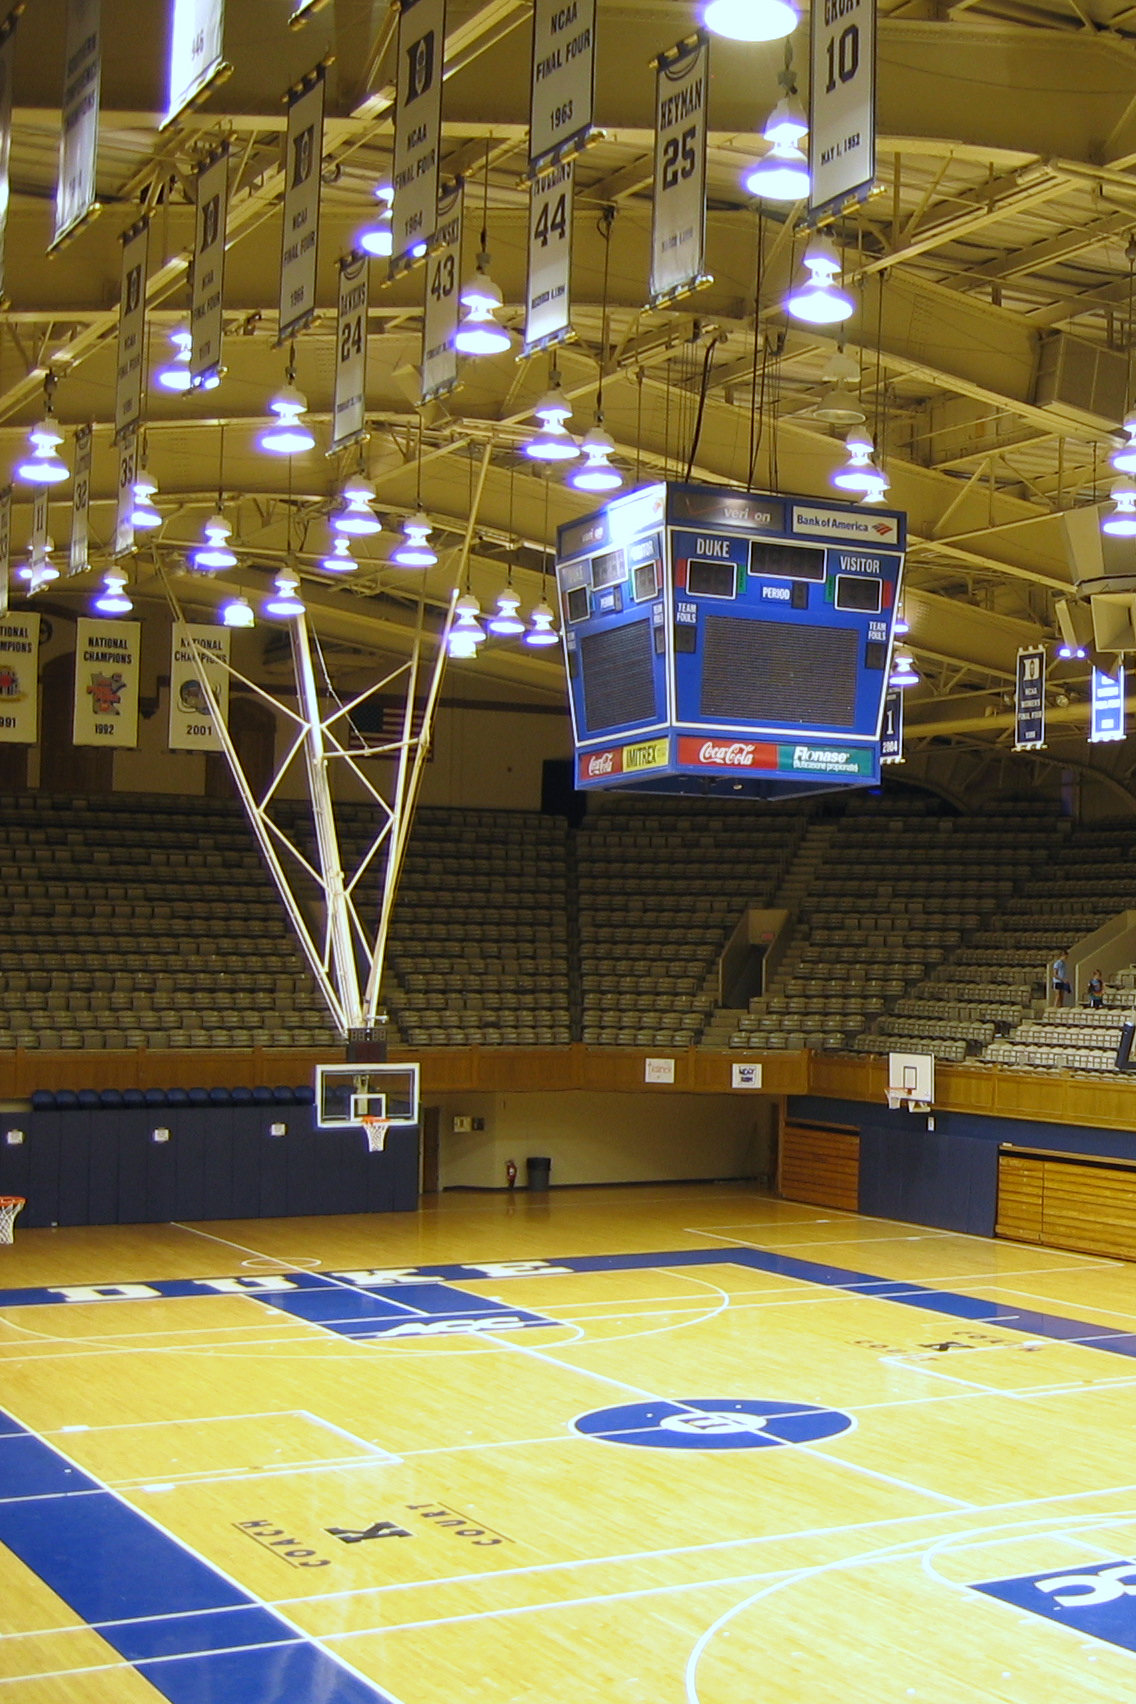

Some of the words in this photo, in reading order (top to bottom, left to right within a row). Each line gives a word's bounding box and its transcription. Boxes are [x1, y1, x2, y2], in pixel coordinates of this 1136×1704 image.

[551, 2, 577, 35] NCAA
[536, 49, 562, 83] FINAL
[566, 29, 590, 63] FOUR
[826, 23, 859, 94] 10
[551, 100, 573, 131] 1963
[660, 77, 702, 131] HEYMAN
[407, 124, 427, 151] NCAA
[395, 167, 414, 190] FINAL
[417, 149, 435, 182] FOUR
[663, 124, 696, 191] 25
[821, 147, 835, 165] MAY
[534, 193, 566, 248] 44
[431, 254, 454, 301] 43
[342, 315, 362, 362] 24
[121, 453, 133, 488] 35
[75, 479, 88, 511] 32
[797, 514, 820, 527] Bank
[820, 517, 832, 529] of
[832, 519, 868, 533] America
[697, 538, 730, 557] DUKE
[840, 556, 880, 573] VISITOR
[762, 587, 790, 600] PERIOD
[676, 613, 696, 624] FOULS
[678, 602, 697, 613] TEAM
[868, 631, 886, 641] FOULS
[869, 621, 886, 632] TEAM
[88, 637, 128, 649] NATIONAL
[83, 652, 132, 665] CHAMPIONS
[95, 724, 114, 735] 1992
[186, 725, 212, 736] 2001
[886, 710, 894, 735] 1
[47, 1261, 576, 1302] DUKE
[376, 1316, 526, 1337] ACC
[406, 1503, 503, 1546] COURT
[239, 1520, 330, 1567] COACH
